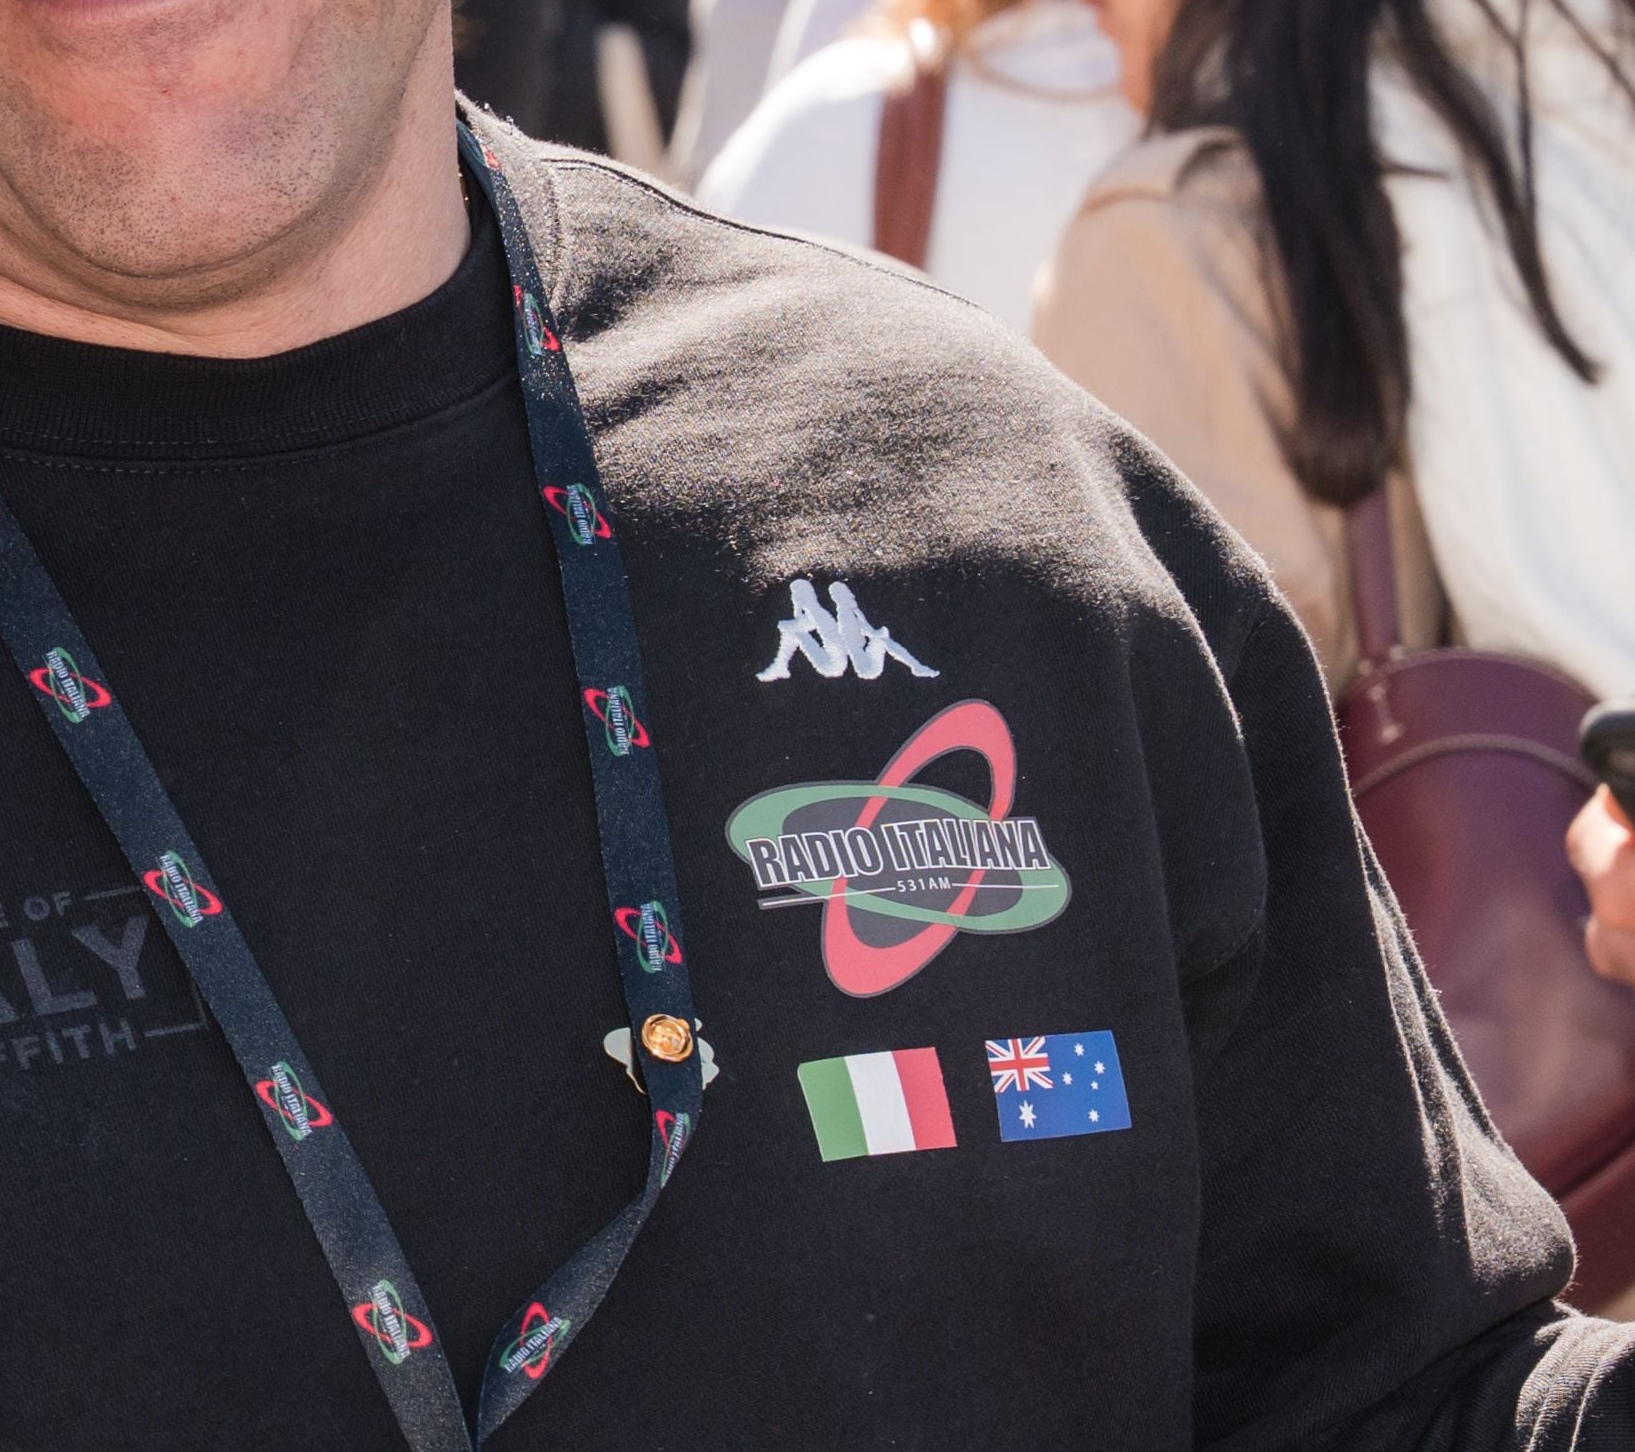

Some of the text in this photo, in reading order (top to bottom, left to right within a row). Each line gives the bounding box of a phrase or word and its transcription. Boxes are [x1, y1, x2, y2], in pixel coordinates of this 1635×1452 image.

[745, 818, 1052, 888] RADIO ITALIANA
[896, 876, 952, 894] 531AM
[23, 890, 73, 921] OF
